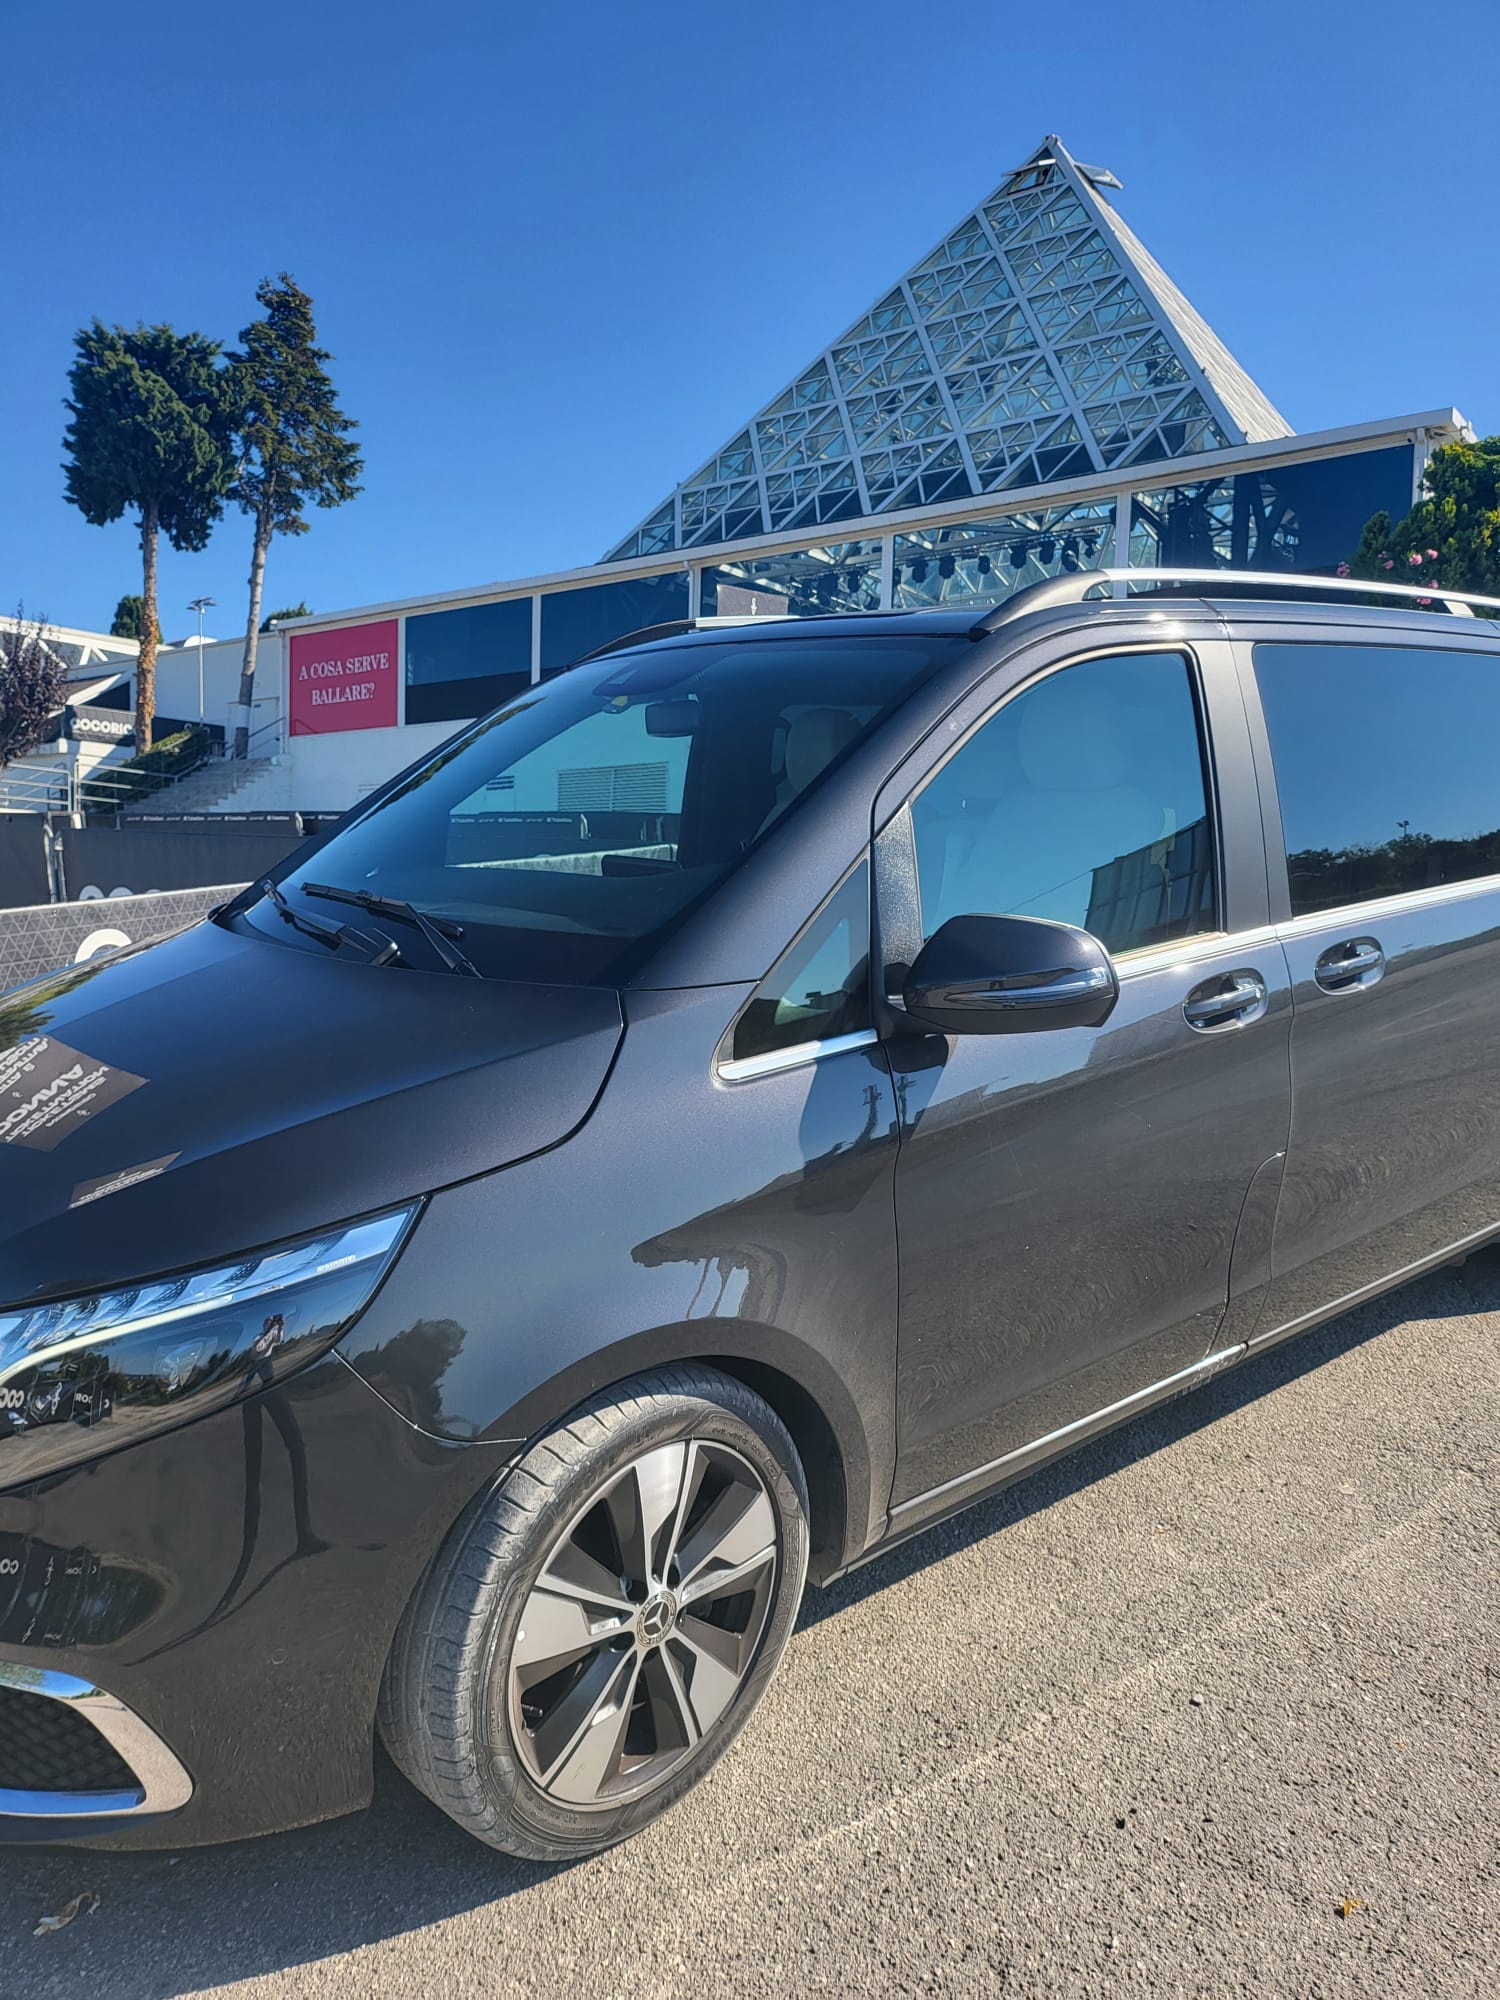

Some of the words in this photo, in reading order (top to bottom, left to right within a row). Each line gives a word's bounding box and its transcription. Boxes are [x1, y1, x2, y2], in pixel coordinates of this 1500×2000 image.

[299, 665, 308, 680] A
[310, 661, 344, 678] COSA
[346, 653, 389, 674] SERVE
[312, 682, 375, 706] BALLARE?
